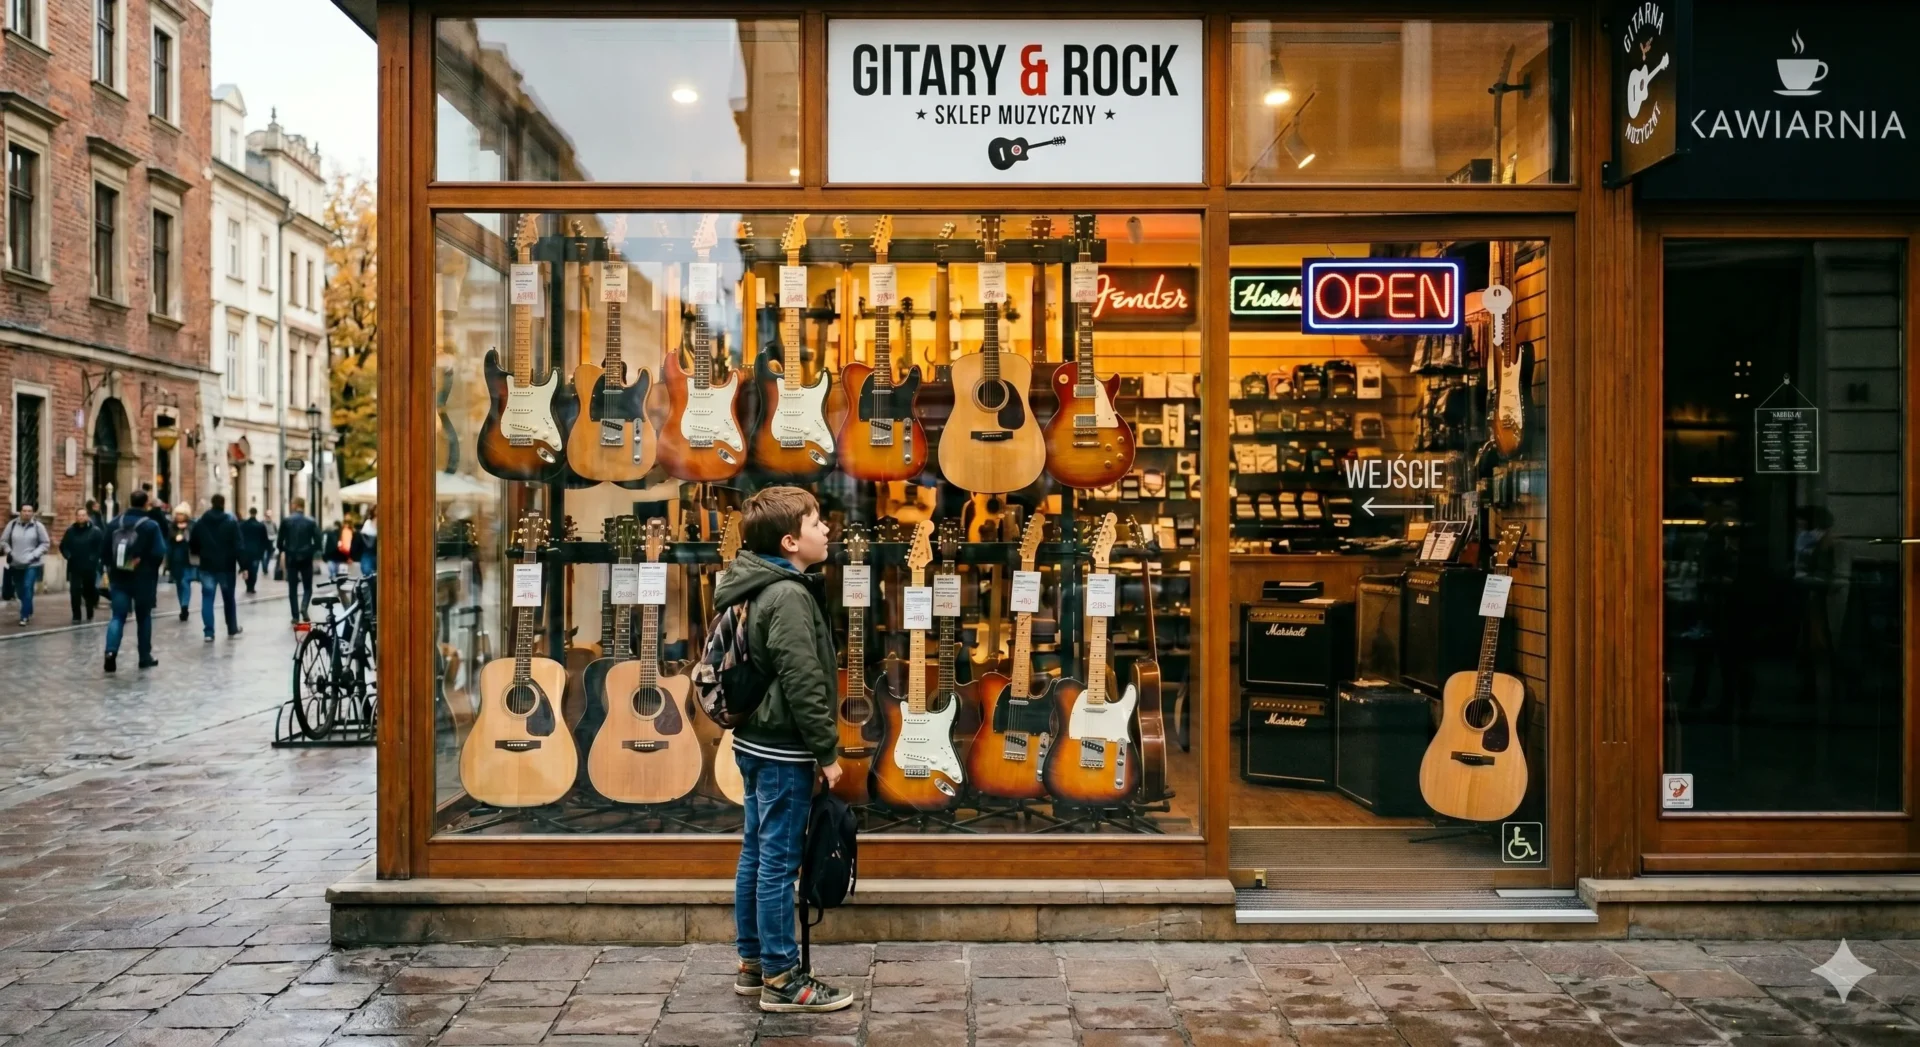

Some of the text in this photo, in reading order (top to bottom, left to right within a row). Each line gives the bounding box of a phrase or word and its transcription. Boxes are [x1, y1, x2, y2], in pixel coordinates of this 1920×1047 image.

[1624, 2, 1664, 53] GITARNA
[853, 44, 1179, 96] GITARY & ROCK
[935, 105, 1096, 125] SKLEP MUZYCZNY
[1092, 274, 1188, 318] Fender
[1315, 273, 1450, 319] OPEN
[1345, 454, 1444, 489] WEJŚCIE
[1266, 623, 1307, 637] Marshall
[1265, 712, 1307, 727] Marshall
